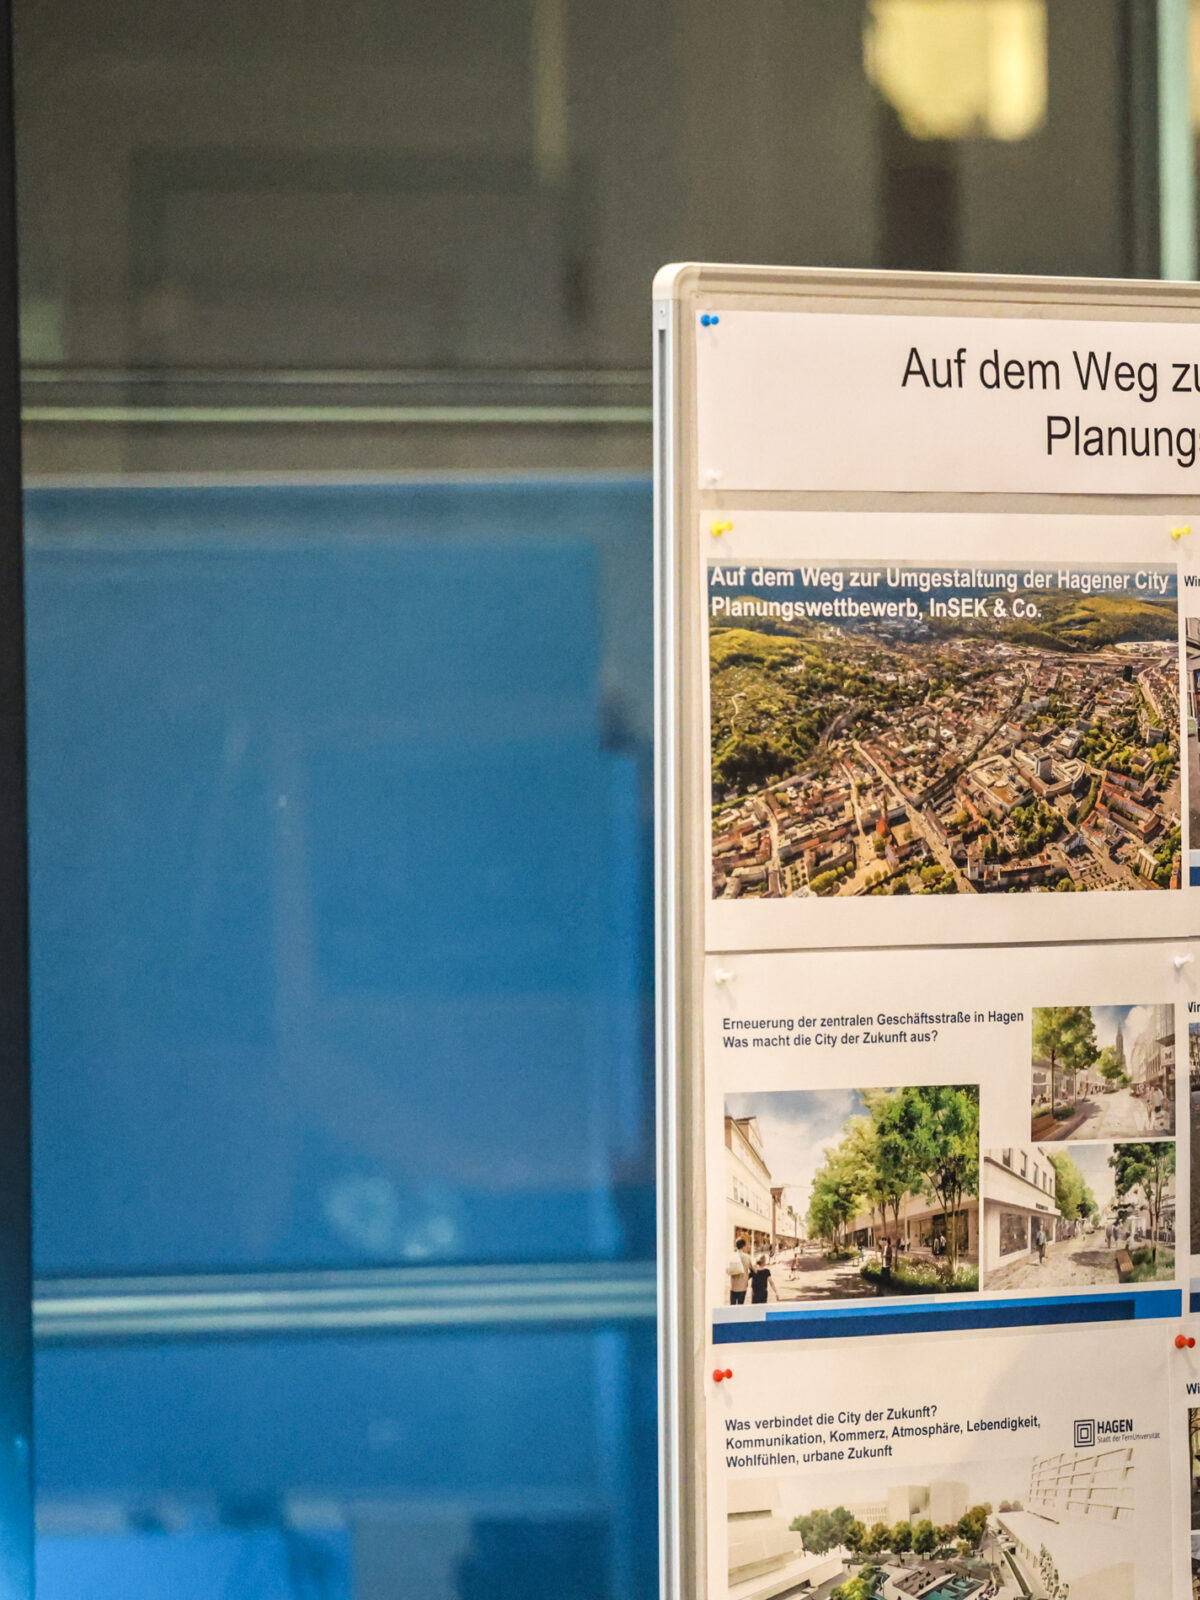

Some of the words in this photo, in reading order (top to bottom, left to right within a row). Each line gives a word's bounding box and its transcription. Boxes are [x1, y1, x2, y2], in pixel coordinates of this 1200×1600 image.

[901, 347, 967, 388] Auf
[979, 349, 1061, 390] dem
[1072, 351, 1158, 402] Weg
[710, 566, 746, 587] Auf
[751, 567, 795, 587] dem
[801, 567, 845, 592] Weg
[849, 570, 881, 587] zur
[886, 567, 1018, 593] Umgestaltung
[1023, 569, 1053, 588] der
[1058, 569, 1130, 594] Hagener
[1135, 570, 1169, 594] City
[711, 596, 924, 621] Planungswettbewerb,
[930, 598, 988, 618] InSEK
[993, 598, 1007, 618] &
[1012, 598, 1042, 618] Co.
[722, 1017, 794, 1031] Erneuerung
[797, 1016, 817, 1028] der
[820, 1014, 873, 1027] zentralen
[876, 1011, 971, 1026] Geschäftsstraße
[974, 1011, 985, 1023] in
[988, 1010, 1024, 1025] Hagen
[722, 1036, 749, 1048] Was
[752, 1034, 790, 1047] macht
[793, 1033, 812, 1046] die
[815, 1033, 838, 1048] City
[840, 1032, 860, 1045] der
[862, 1031, 907, 1044] Zukunft
[910, 1029, 938, 1043] aus?
[725, 1418, 751, 1431] Was
[754, 1414, 813, 1429] verbindet
[816, 1413, 835, 1426] die
[837, 1411, 861, 1426] City
[864, 1410, 884, 1423] der
[886, 1404, 938, 1421] Zukunft?
[1097, 1419, 1133, 1435] HAGEN
[726, 1432, 826, 1450] Kommunikation,
[829, 1428, 889, 1443] Kommerz,
[891, 1421, 964, 1438] Atmosphäre,
[966, 1415, 1041, 1433] Lebendigkeit,
[1112, 1433, 1121, 1442] der
[726, 1452, 800, 1468] Wohlfühlen,
[802, 1449, 845, 1463] urbane
[847, 1444, 893, 1460] Zukunft
